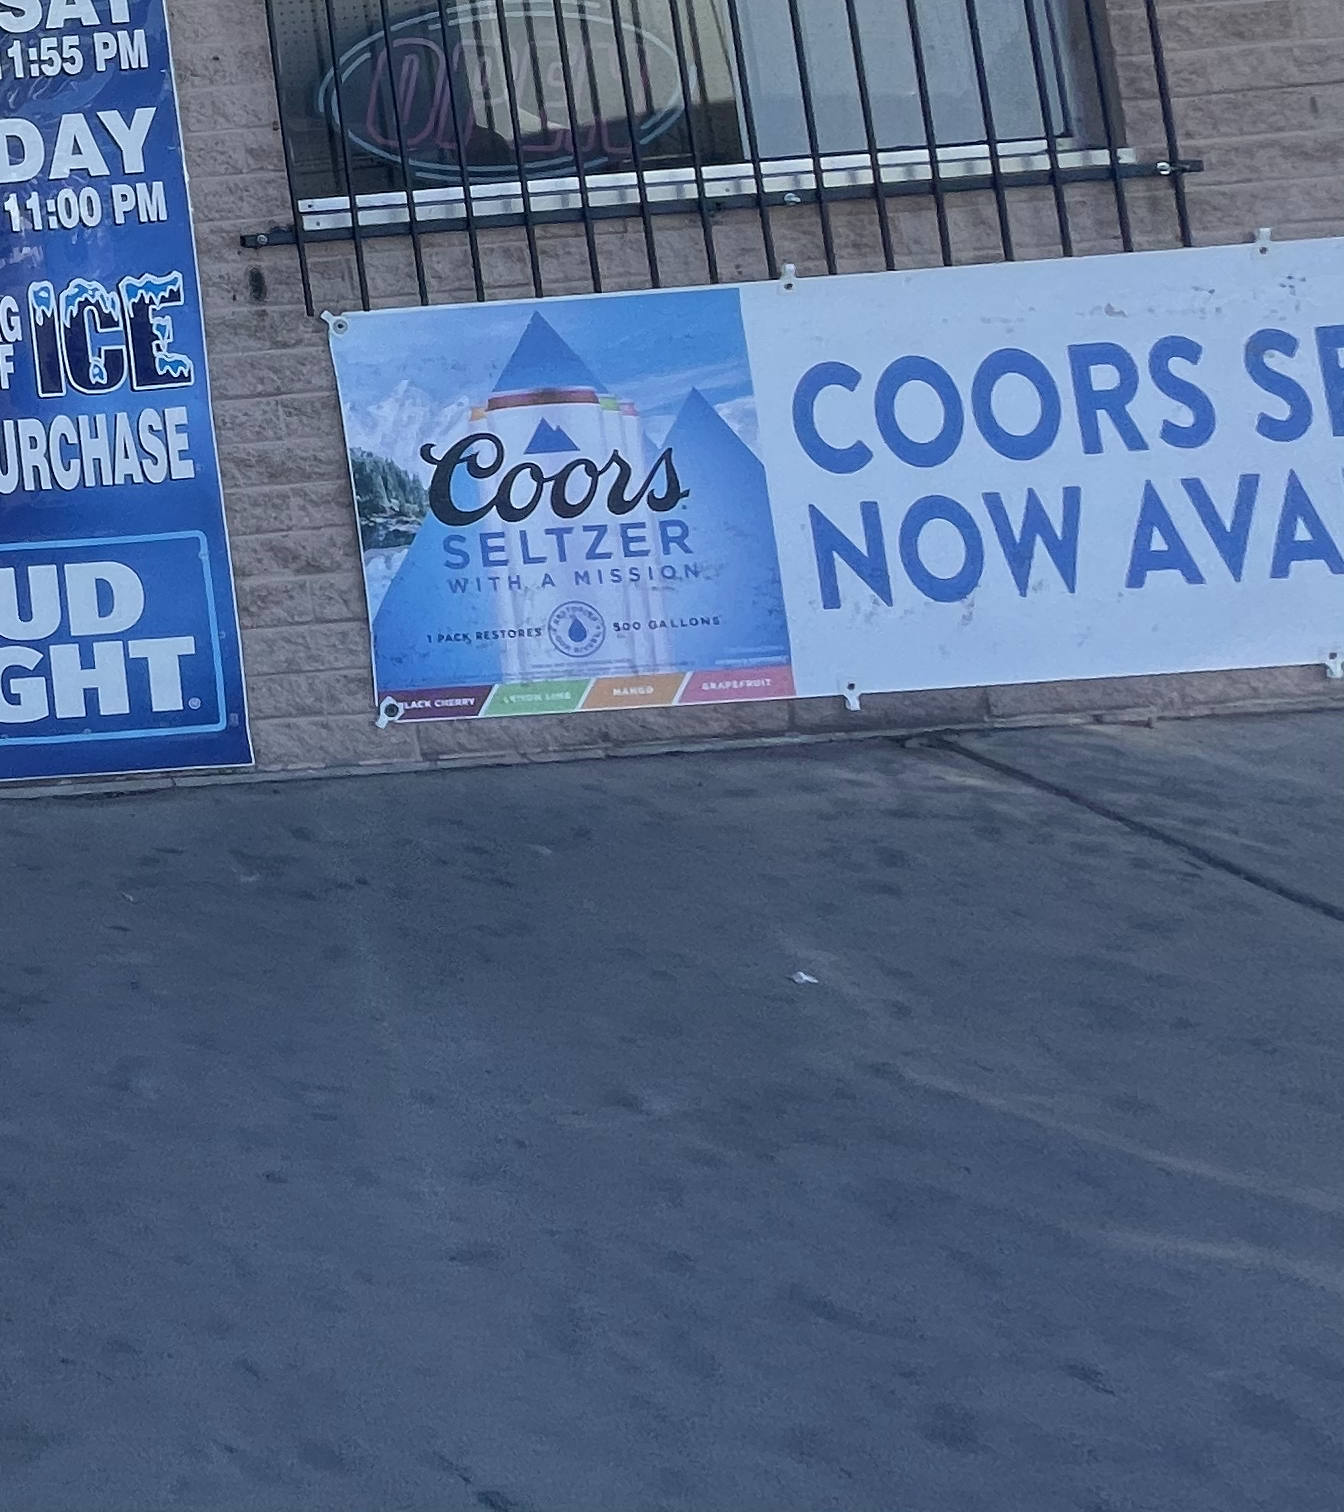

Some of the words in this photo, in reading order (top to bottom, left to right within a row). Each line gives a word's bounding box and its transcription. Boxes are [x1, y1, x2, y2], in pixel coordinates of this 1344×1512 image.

[94, 29, 149, 72] PM
[3, 188, 103, 233] 11:00
[113, 181, 168, 225] PM
[26, 270, 196, 399] ICE
[792, 334, 1216, 474] COORS
[420, 431, 691, 527] Coors
[442, 519, 694, 571] SELTZER
[808, 486, 1081, 609] NOW
[448, 574, 521, 594] WITH
[540, 572, 557, 589] A
[574, 563, 701, 587] MISSION
[437, 631, 473, 645] PACK
[475, 627, 543, 642] RESTORES
[613, 621, 641, 633] 500
[648, 615, 722, 631] GALLONS
[434, 697, 475, 708] CHERRY
[613, 685, 654, 697] MANGO
[701, 678, 773, 691] GRAPEFRUIT
